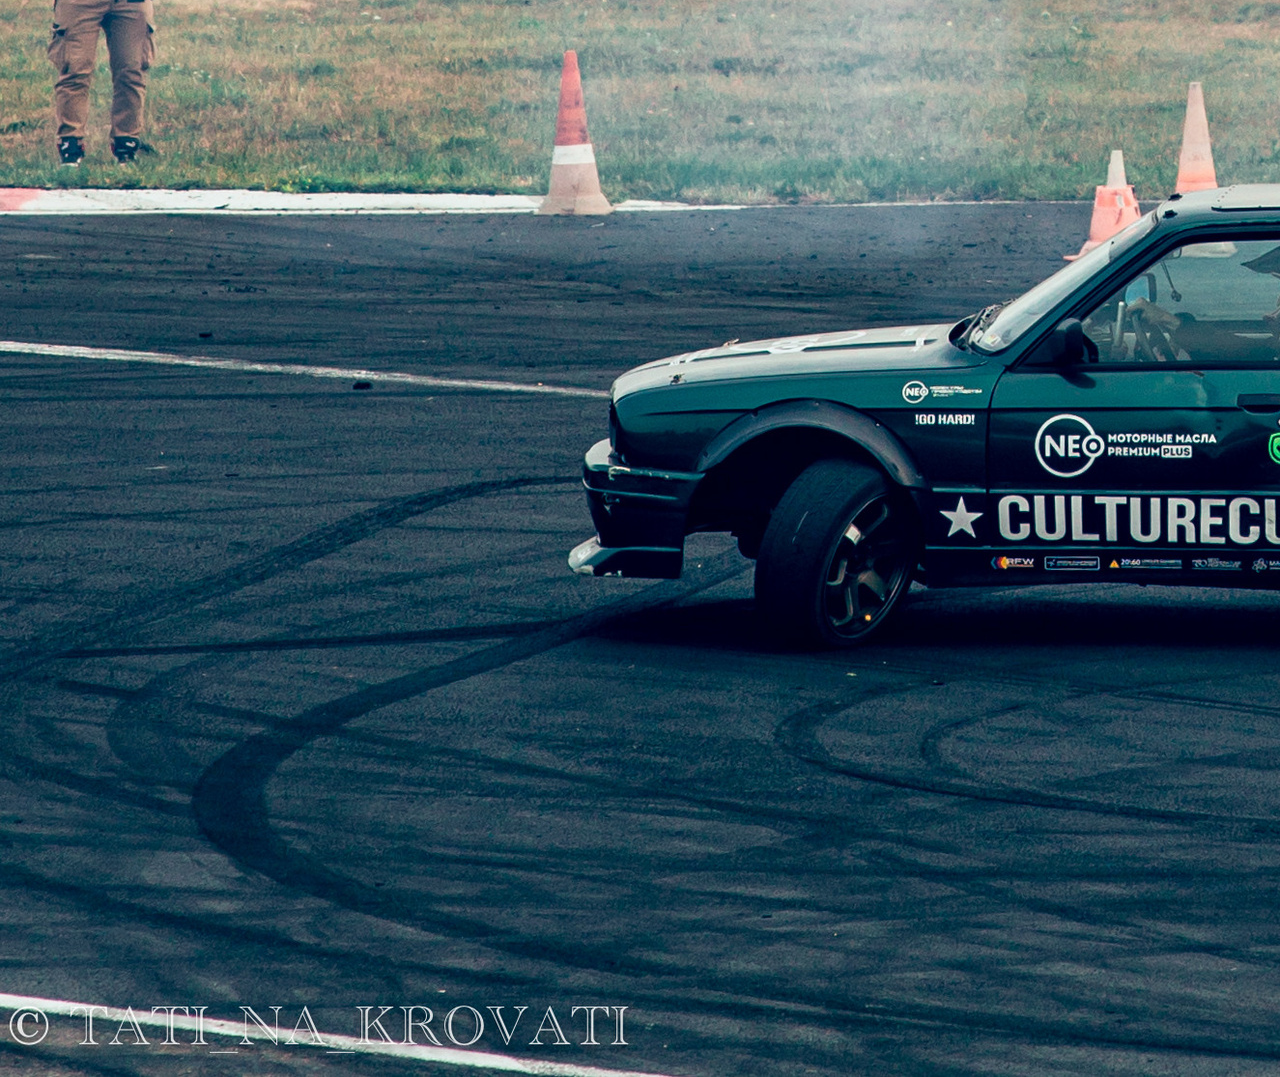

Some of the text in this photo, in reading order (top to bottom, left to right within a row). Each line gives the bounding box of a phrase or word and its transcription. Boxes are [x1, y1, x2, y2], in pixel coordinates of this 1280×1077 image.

[905, 387, 929, 397] NEO
[915, 414, 975, 425] !GO HARD!
[1107, 433, 1217, 444] МОТОРНЫЕ МАСЛА
[1045, 434, 1105, 458] NEO
[1107, 446, 1191, 457] PREMIUM PLUS
